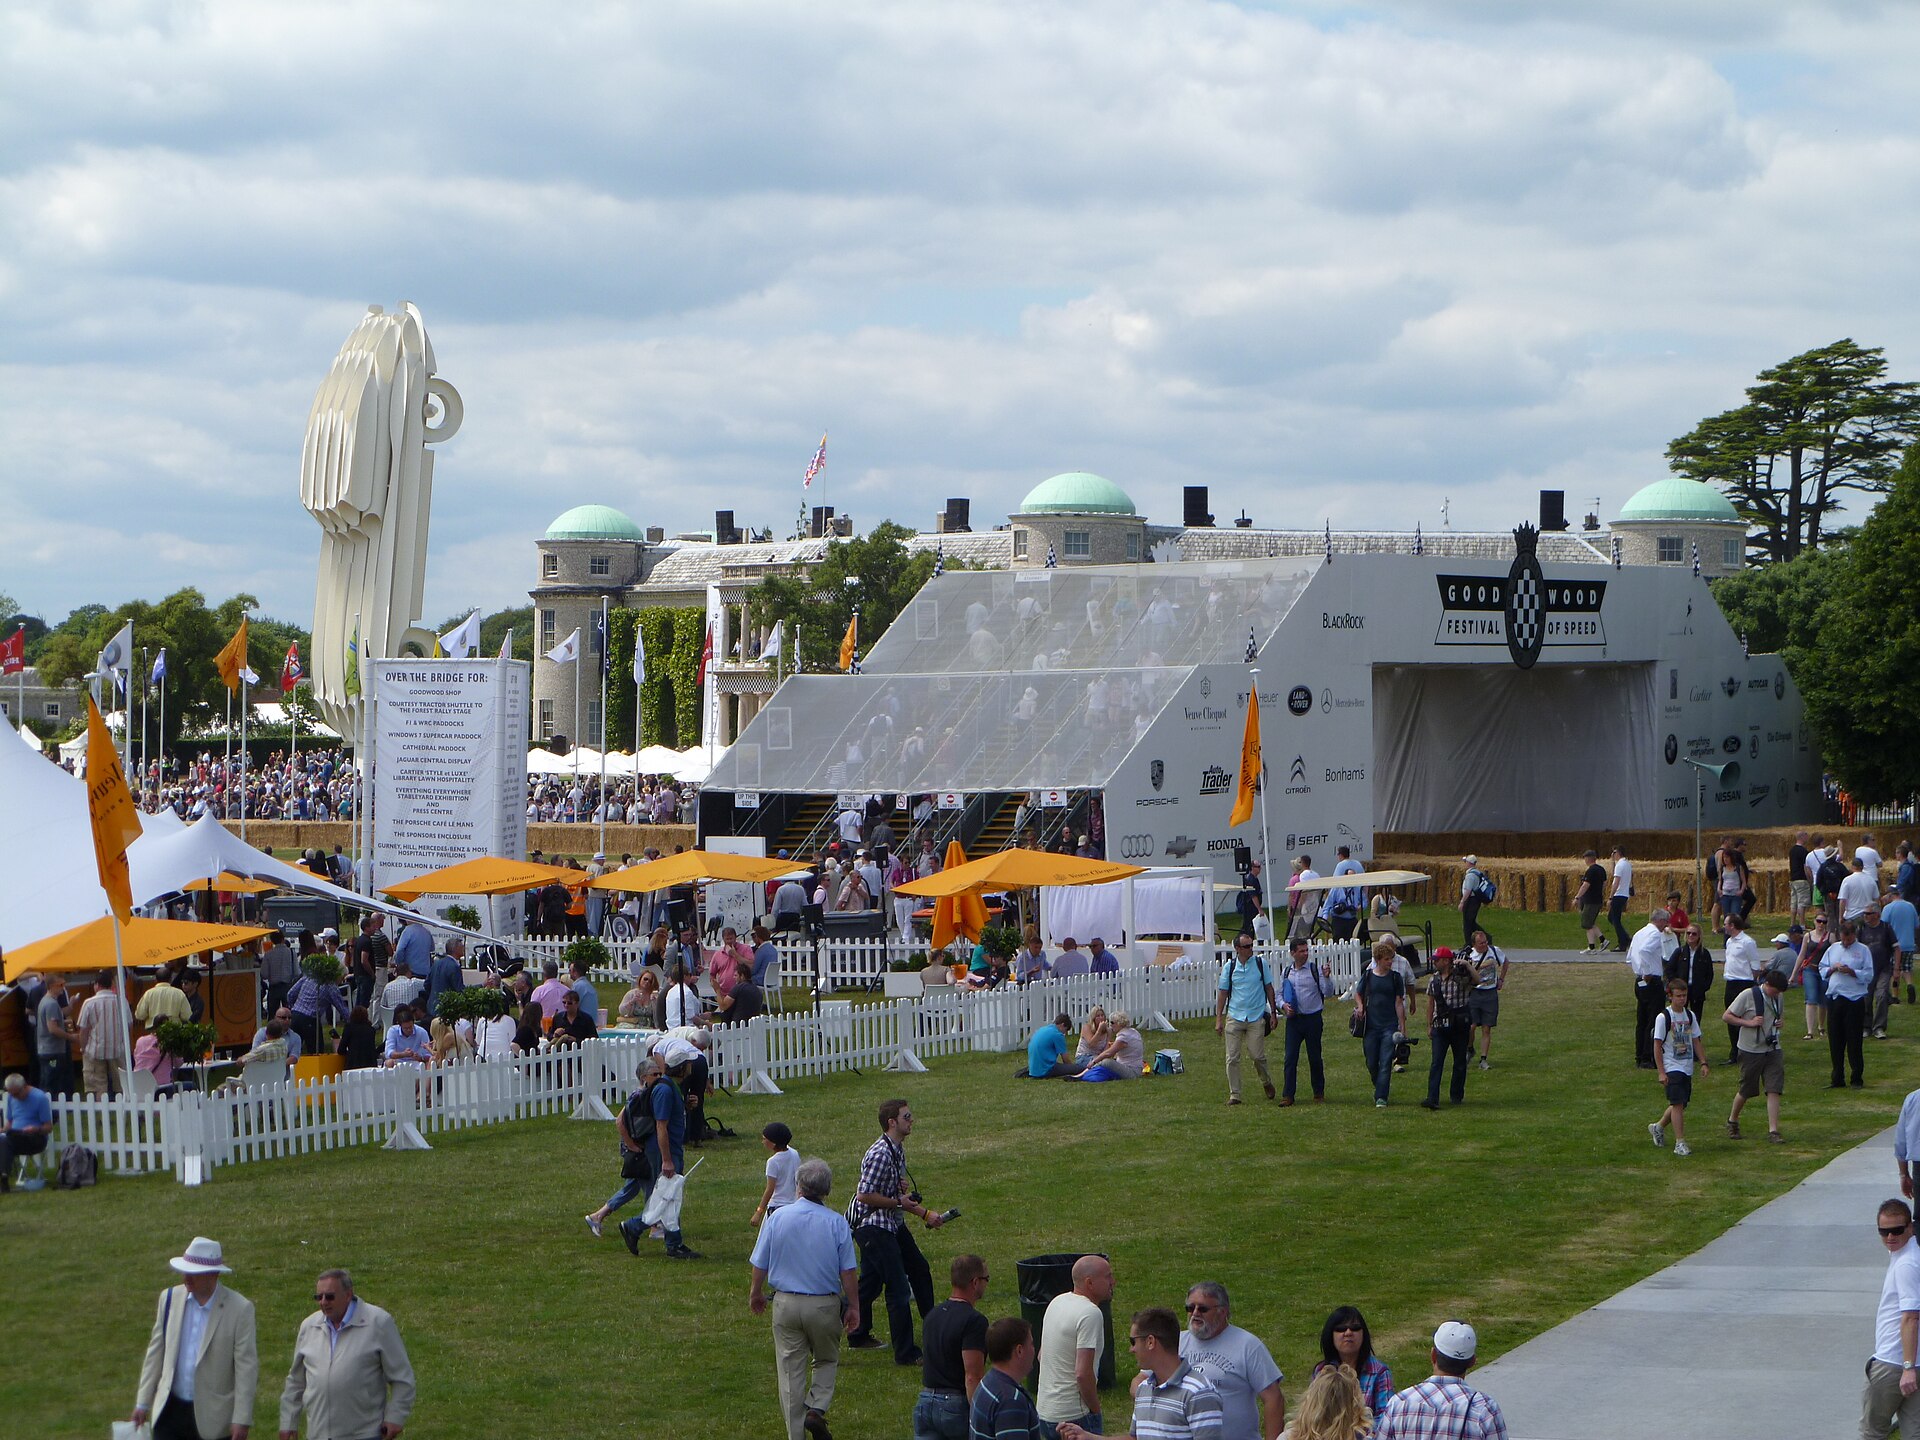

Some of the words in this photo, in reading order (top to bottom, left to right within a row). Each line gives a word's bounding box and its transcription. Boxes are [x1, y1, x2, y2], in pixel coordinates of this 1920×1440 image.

[1448, 585, 1500, 603] GOOD
[1549, 589, 1597, 605] WOOD
[1447, 620, 1500, 635] FESTIVAL
[1548, 621, 1560, 635] OF
[1564, 621, 1597, 635] SPEED
[385, 672, 408, 682] OVER
[409, 672, 427, 682] THE
[430, 673, 464, 683] BRIDGE
[467, 673, 488, 683] FOR:
[1292, 691, 1306, 700] LAND
[1293, 700, 1309, 709] ROVER
[1184, 707, 1201, 720] Veuve
[1202, 706, 1227, 722] Clicquot
[1208, 765, 1222, 774] Auto
[1325, 766, 1365, 782] Bonhams
[1202, 770, 1233, 788] Trader
[1136, 797, 1179, 806] PORSCHE
[1664, 796, 1689, 810] TOYOTA
[1715, 790, 1742, 803] NISSAN
[1206, 838, 1245, 851] HONDA
[1298, 834, 1329, 846] SEAT
